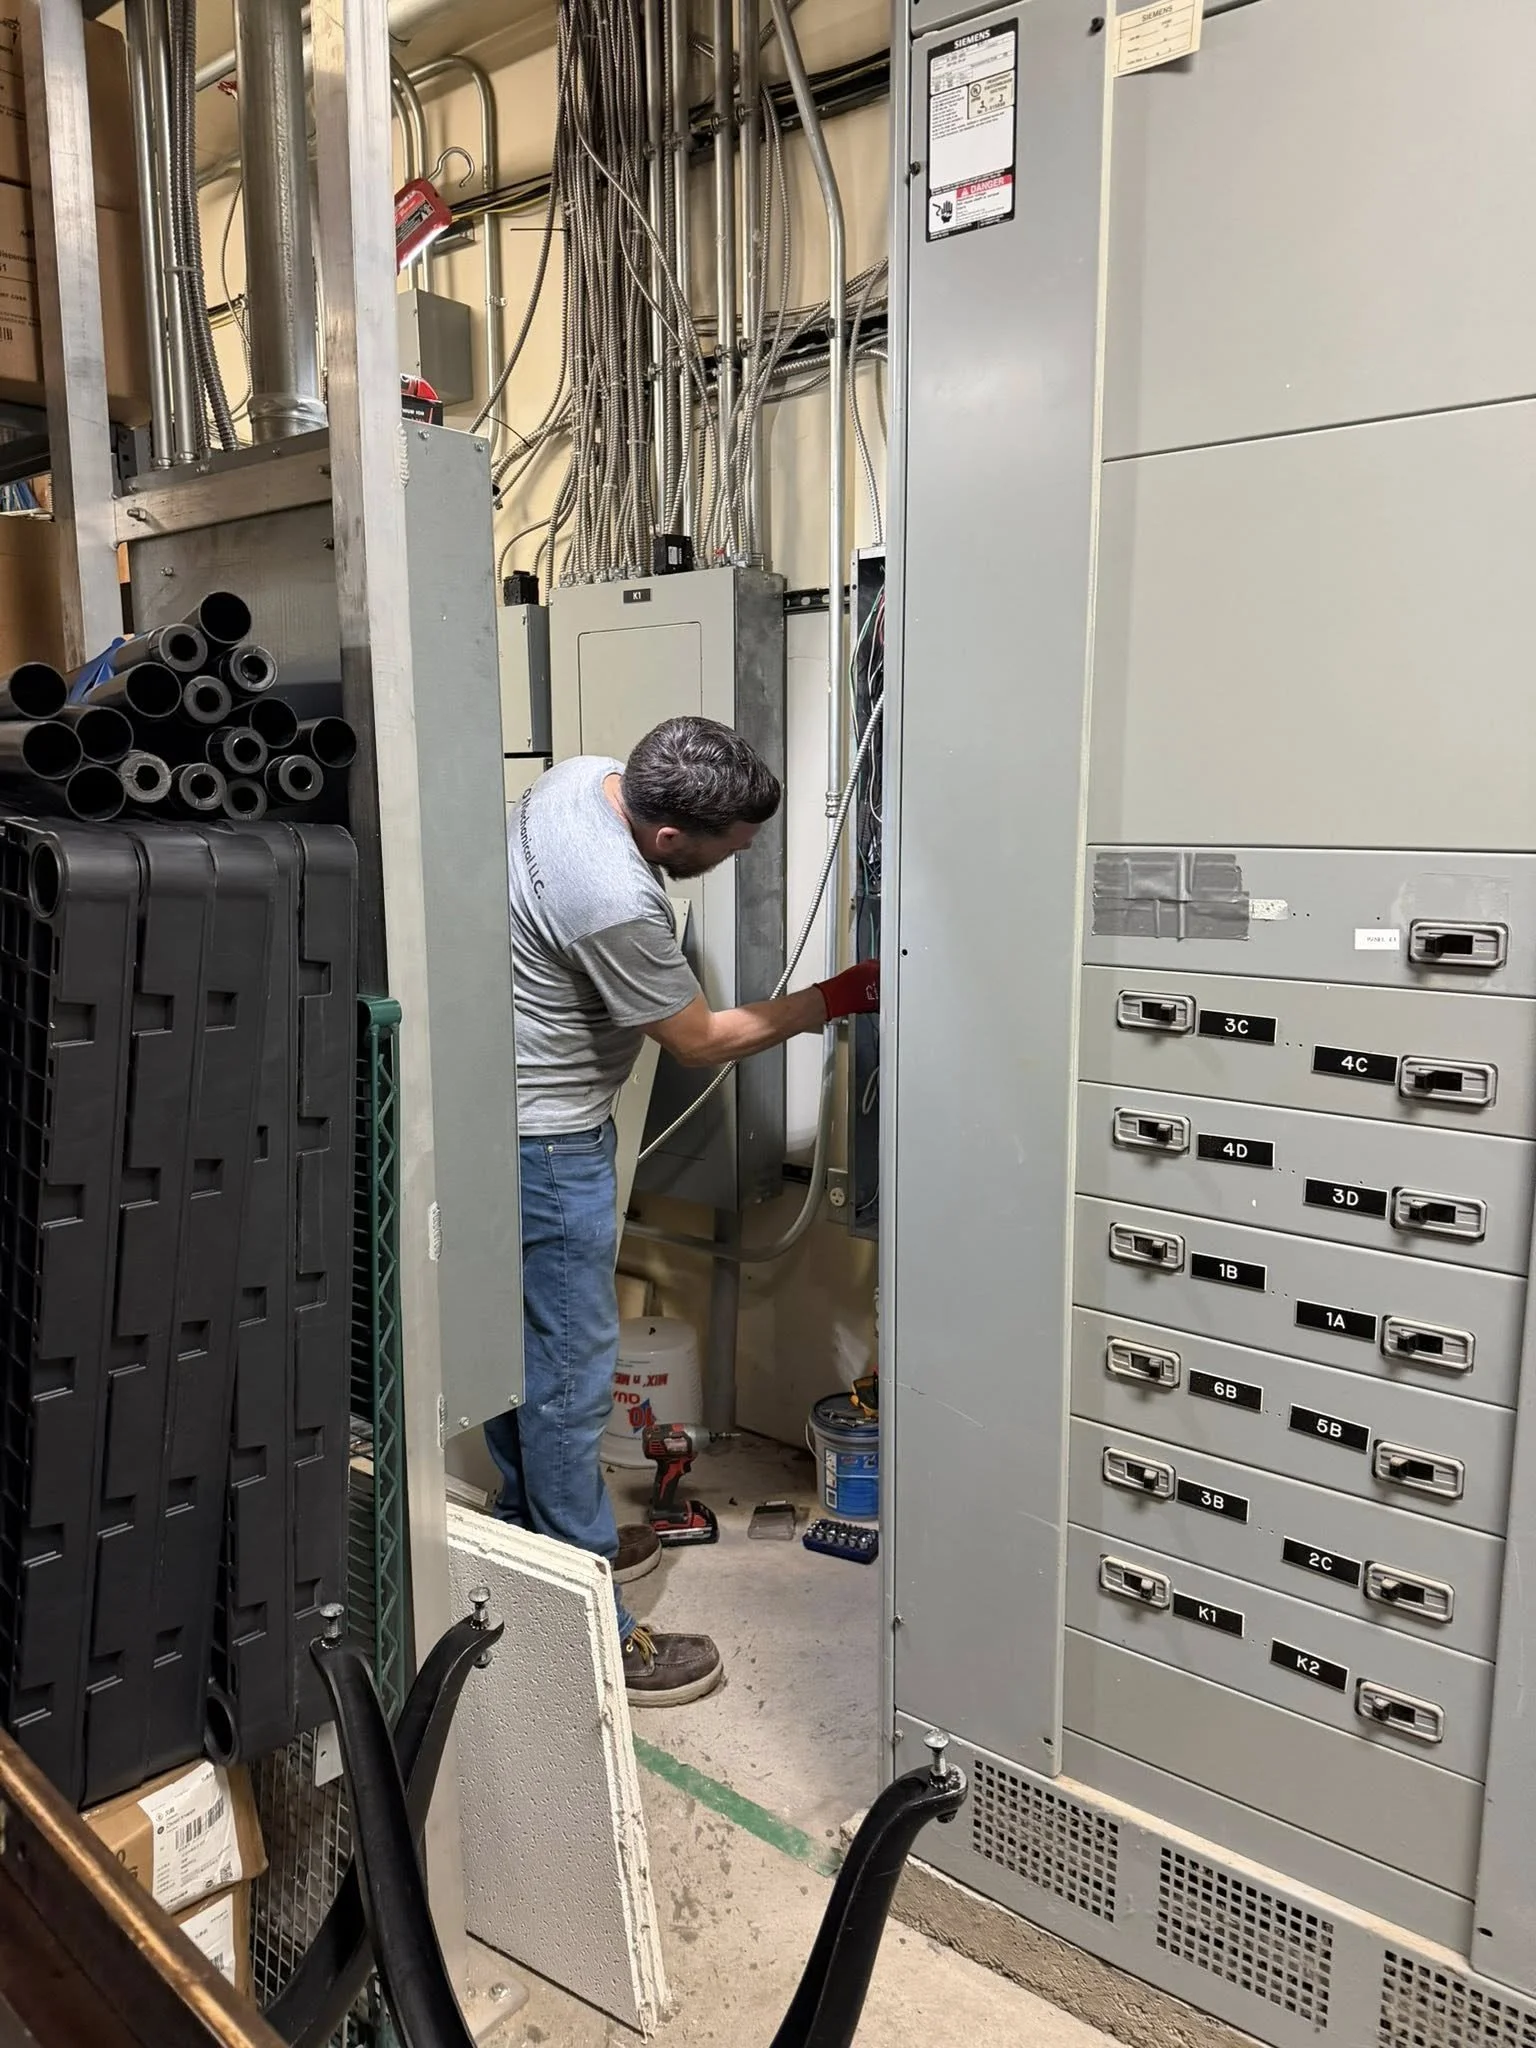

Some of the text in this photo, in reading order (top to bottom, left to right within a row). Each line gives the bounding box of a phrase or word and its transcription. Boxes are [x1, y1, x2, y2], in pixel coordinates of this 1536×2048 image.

[1142, 5, 1173, 22] SIEMENS
[954, 29, 991, 49] SIEMENS
[970, 176, 1005, 194] DANGER
[632, 591, 642, 601] K1
[527, 863, 545, 900] LLC.
[1224, 1018, 1249, 1035] 3C
[1341, 1056, 1369, 1074] 4C
[1222, 1143, 1248, 1159] 4D
[1332, 1188, 1359, 1206] 3D
[1219, 1263, 1238, 1280] 1B
[1326, 1312, 1346, 1330] 1A
[1213, 1381, 1237, 1399] 6B
[629, 1407, 656, 1428] 10
[1316, 1419, 1342, 1438] 5B
[1201, 1491, 1225, 1510] 3B
[1308, 1552, 1333, 1571] 2C
[1198, 1606, 1217, 1623] K1
[1296, 1655, 1320, 1675] K2
